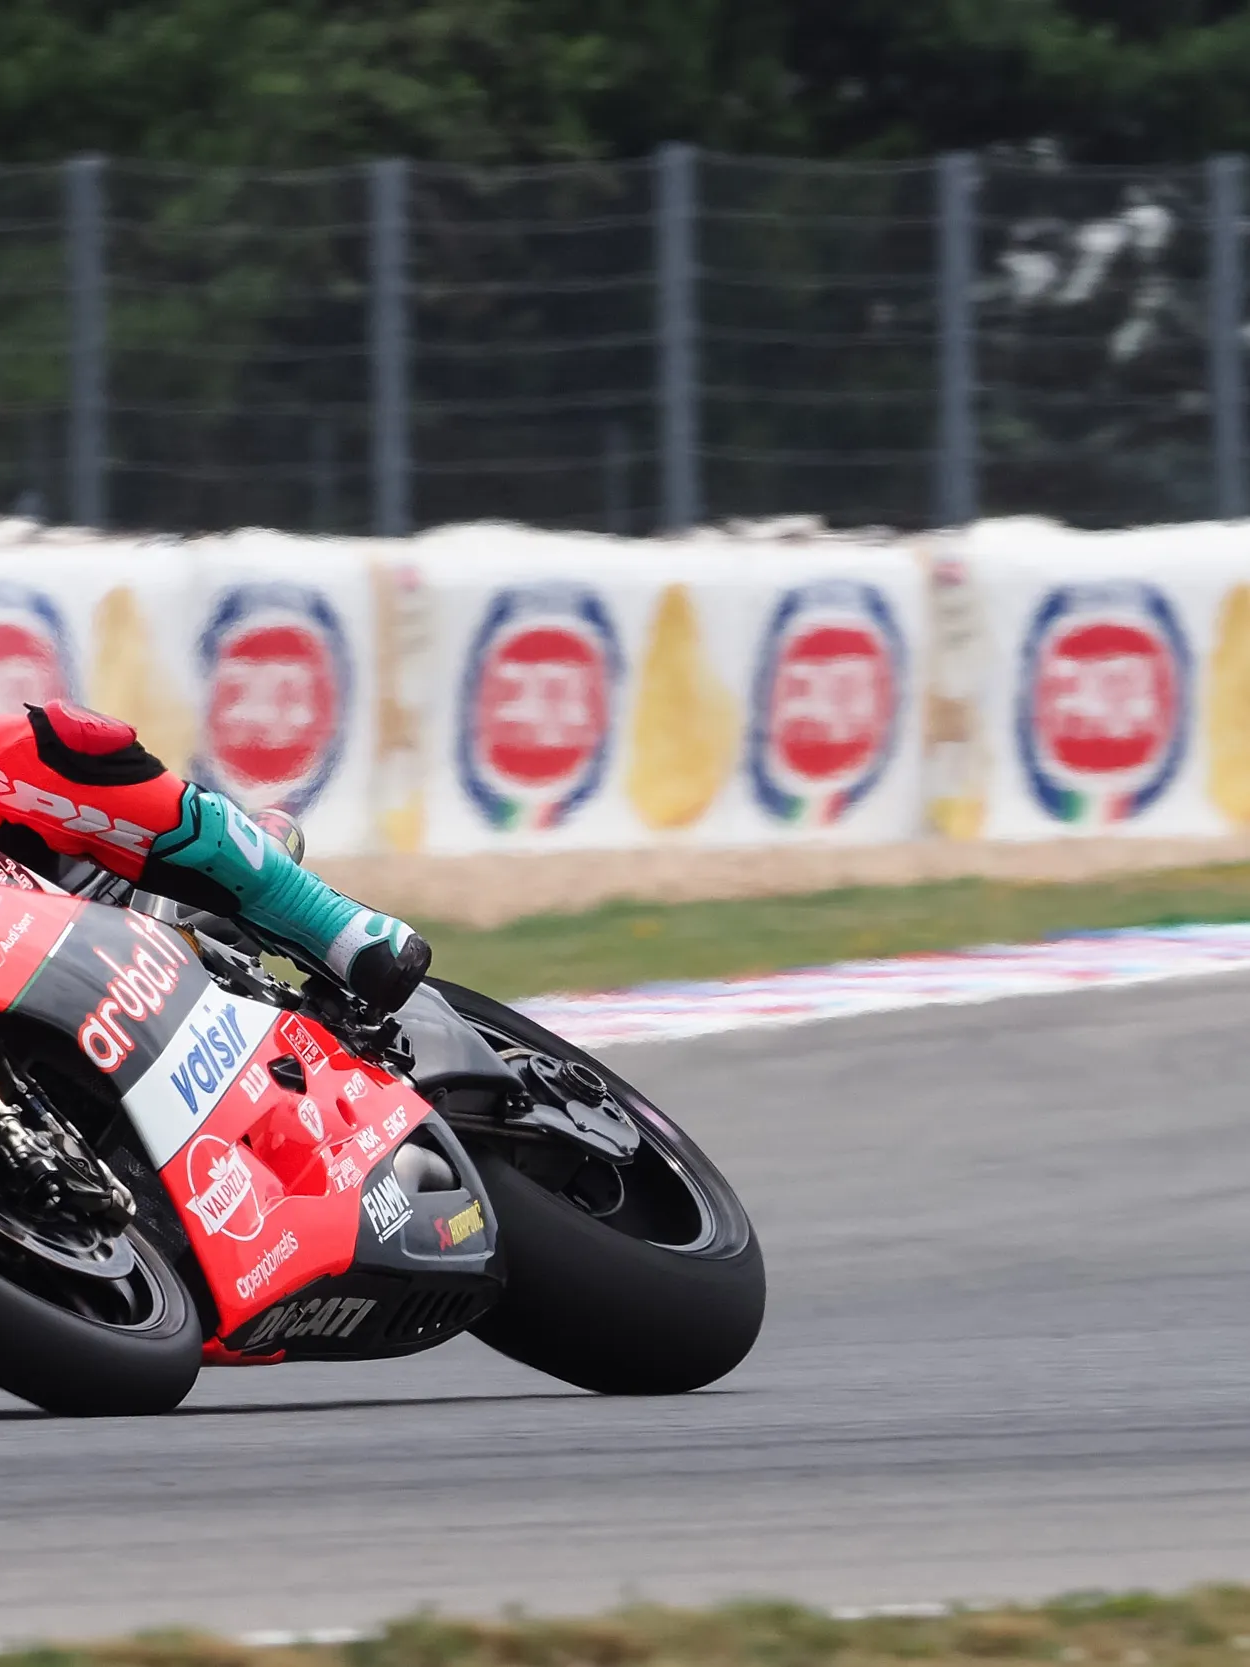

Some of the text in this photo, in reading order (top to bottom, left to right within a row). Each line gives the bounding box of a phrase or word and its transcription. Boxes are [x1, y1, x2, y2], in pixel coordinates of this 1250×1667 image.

[0, 912, 35, 953] Audi Sport
[78, 907, 190, 1075] aruba.it
[170, 1003, 248, 1115] valsir
[356, 1125, 382, 1153] NGK
[382, 1104, 408, 1140] SKF
